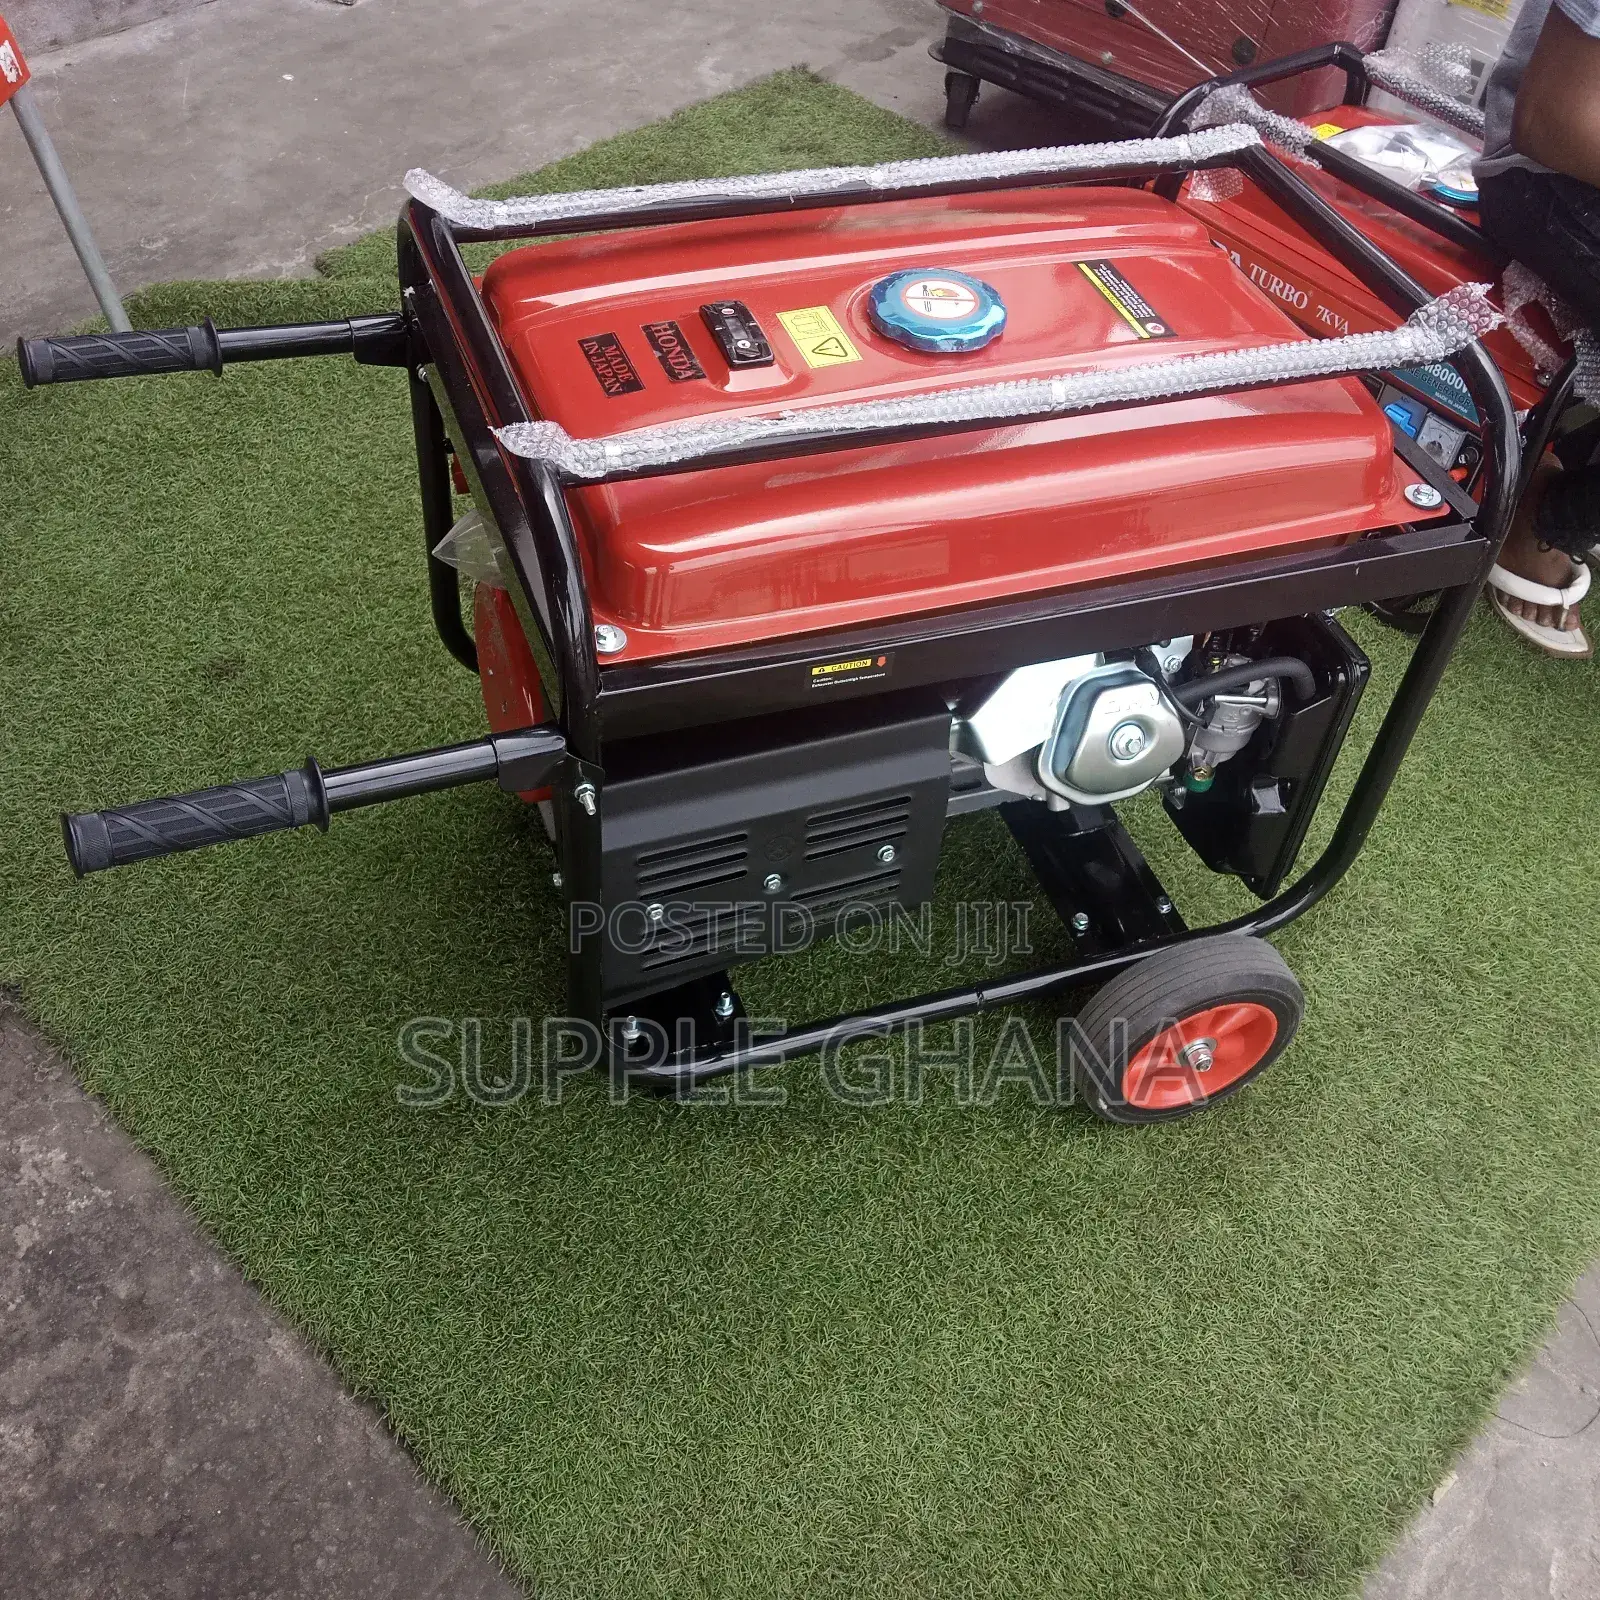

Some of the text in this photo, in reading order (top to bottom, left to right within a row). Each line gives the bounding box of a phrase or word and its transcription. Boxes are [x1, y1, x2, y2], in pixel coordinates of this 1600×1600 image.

[1250, 263, 1308, 309] TURBO
[1316, 305, 1349, 334] 7KVA
[584, 341, 623, 393] IN JAPAN
[602, 344, 634, 382] MADE
[651, 323, 696, 379] HONDA
[1421, 373, 1470, 405] GENERATOR
[831, 660, 868, 672] CAUTION
